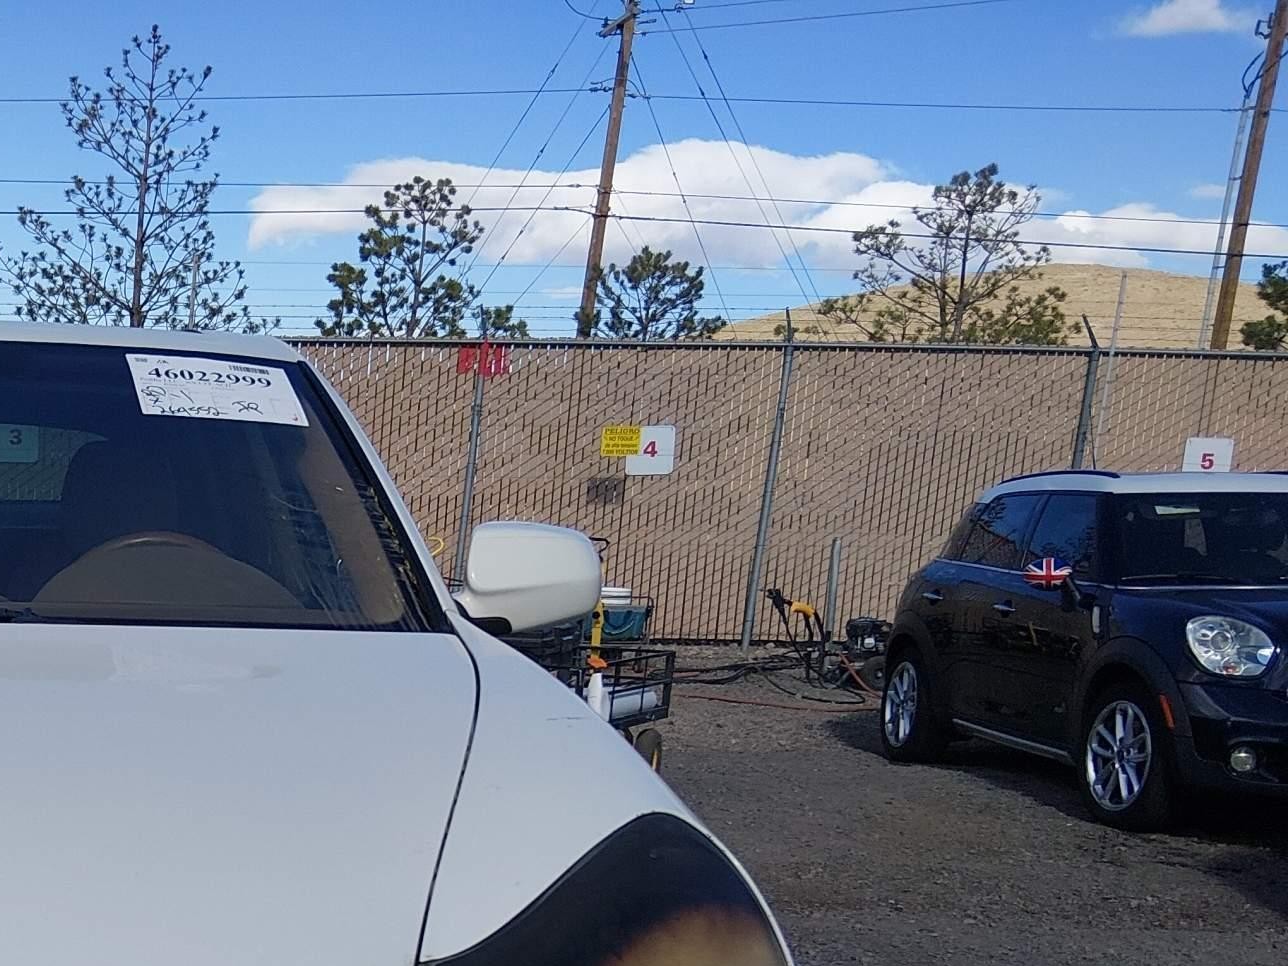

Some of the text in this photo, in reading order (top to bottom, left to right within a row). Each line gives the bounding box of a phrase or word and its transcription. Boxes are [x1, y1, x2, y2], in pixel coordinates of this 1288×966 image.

[147, 367, 272, 388] 46022999
[9, 429, 22, 445] 3
[643, 441, 658, 457] 4
[1201, 453, 1214, 470] 5
